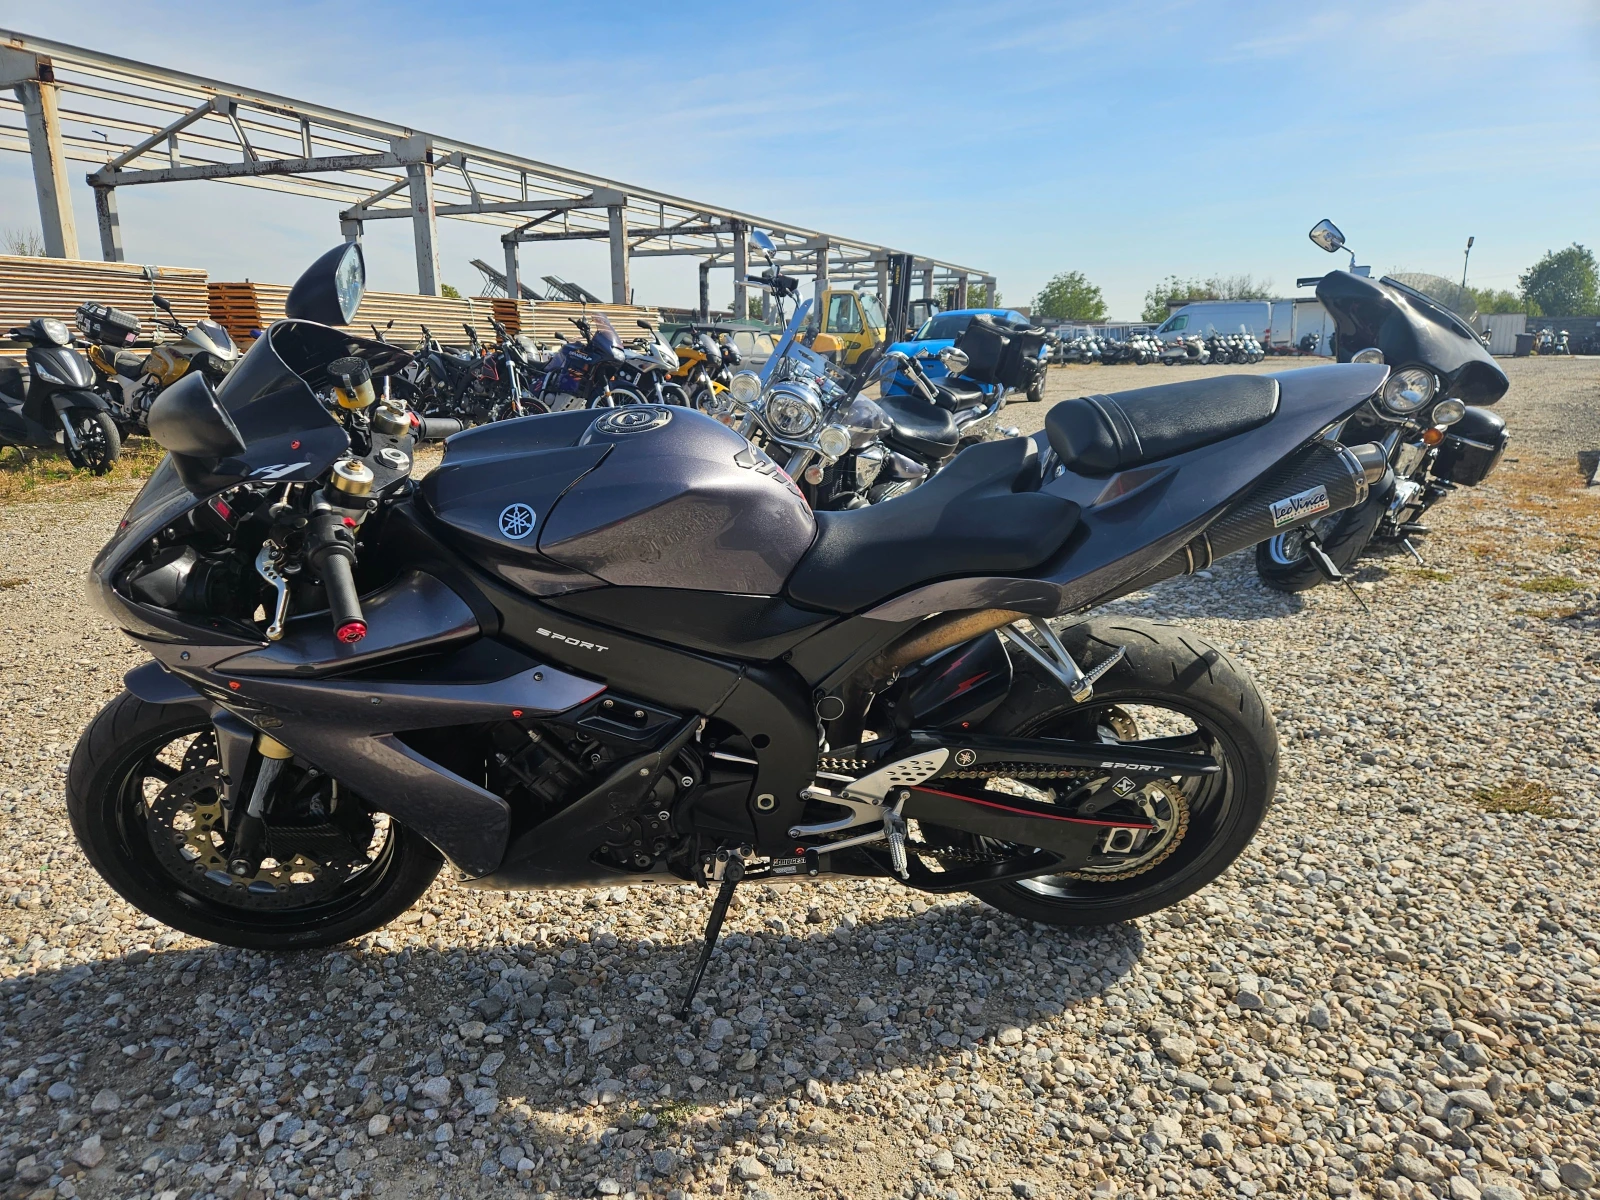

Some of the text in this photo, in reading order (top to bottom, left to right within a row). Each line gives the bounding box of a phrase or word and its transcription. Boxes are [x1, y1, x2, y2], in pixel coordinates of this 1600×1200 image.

[1273, 494, 1326, 520] LeoVince
[535, 627, 609, 652] SPORT
[1100, 761, 1165, 772] SPORT
